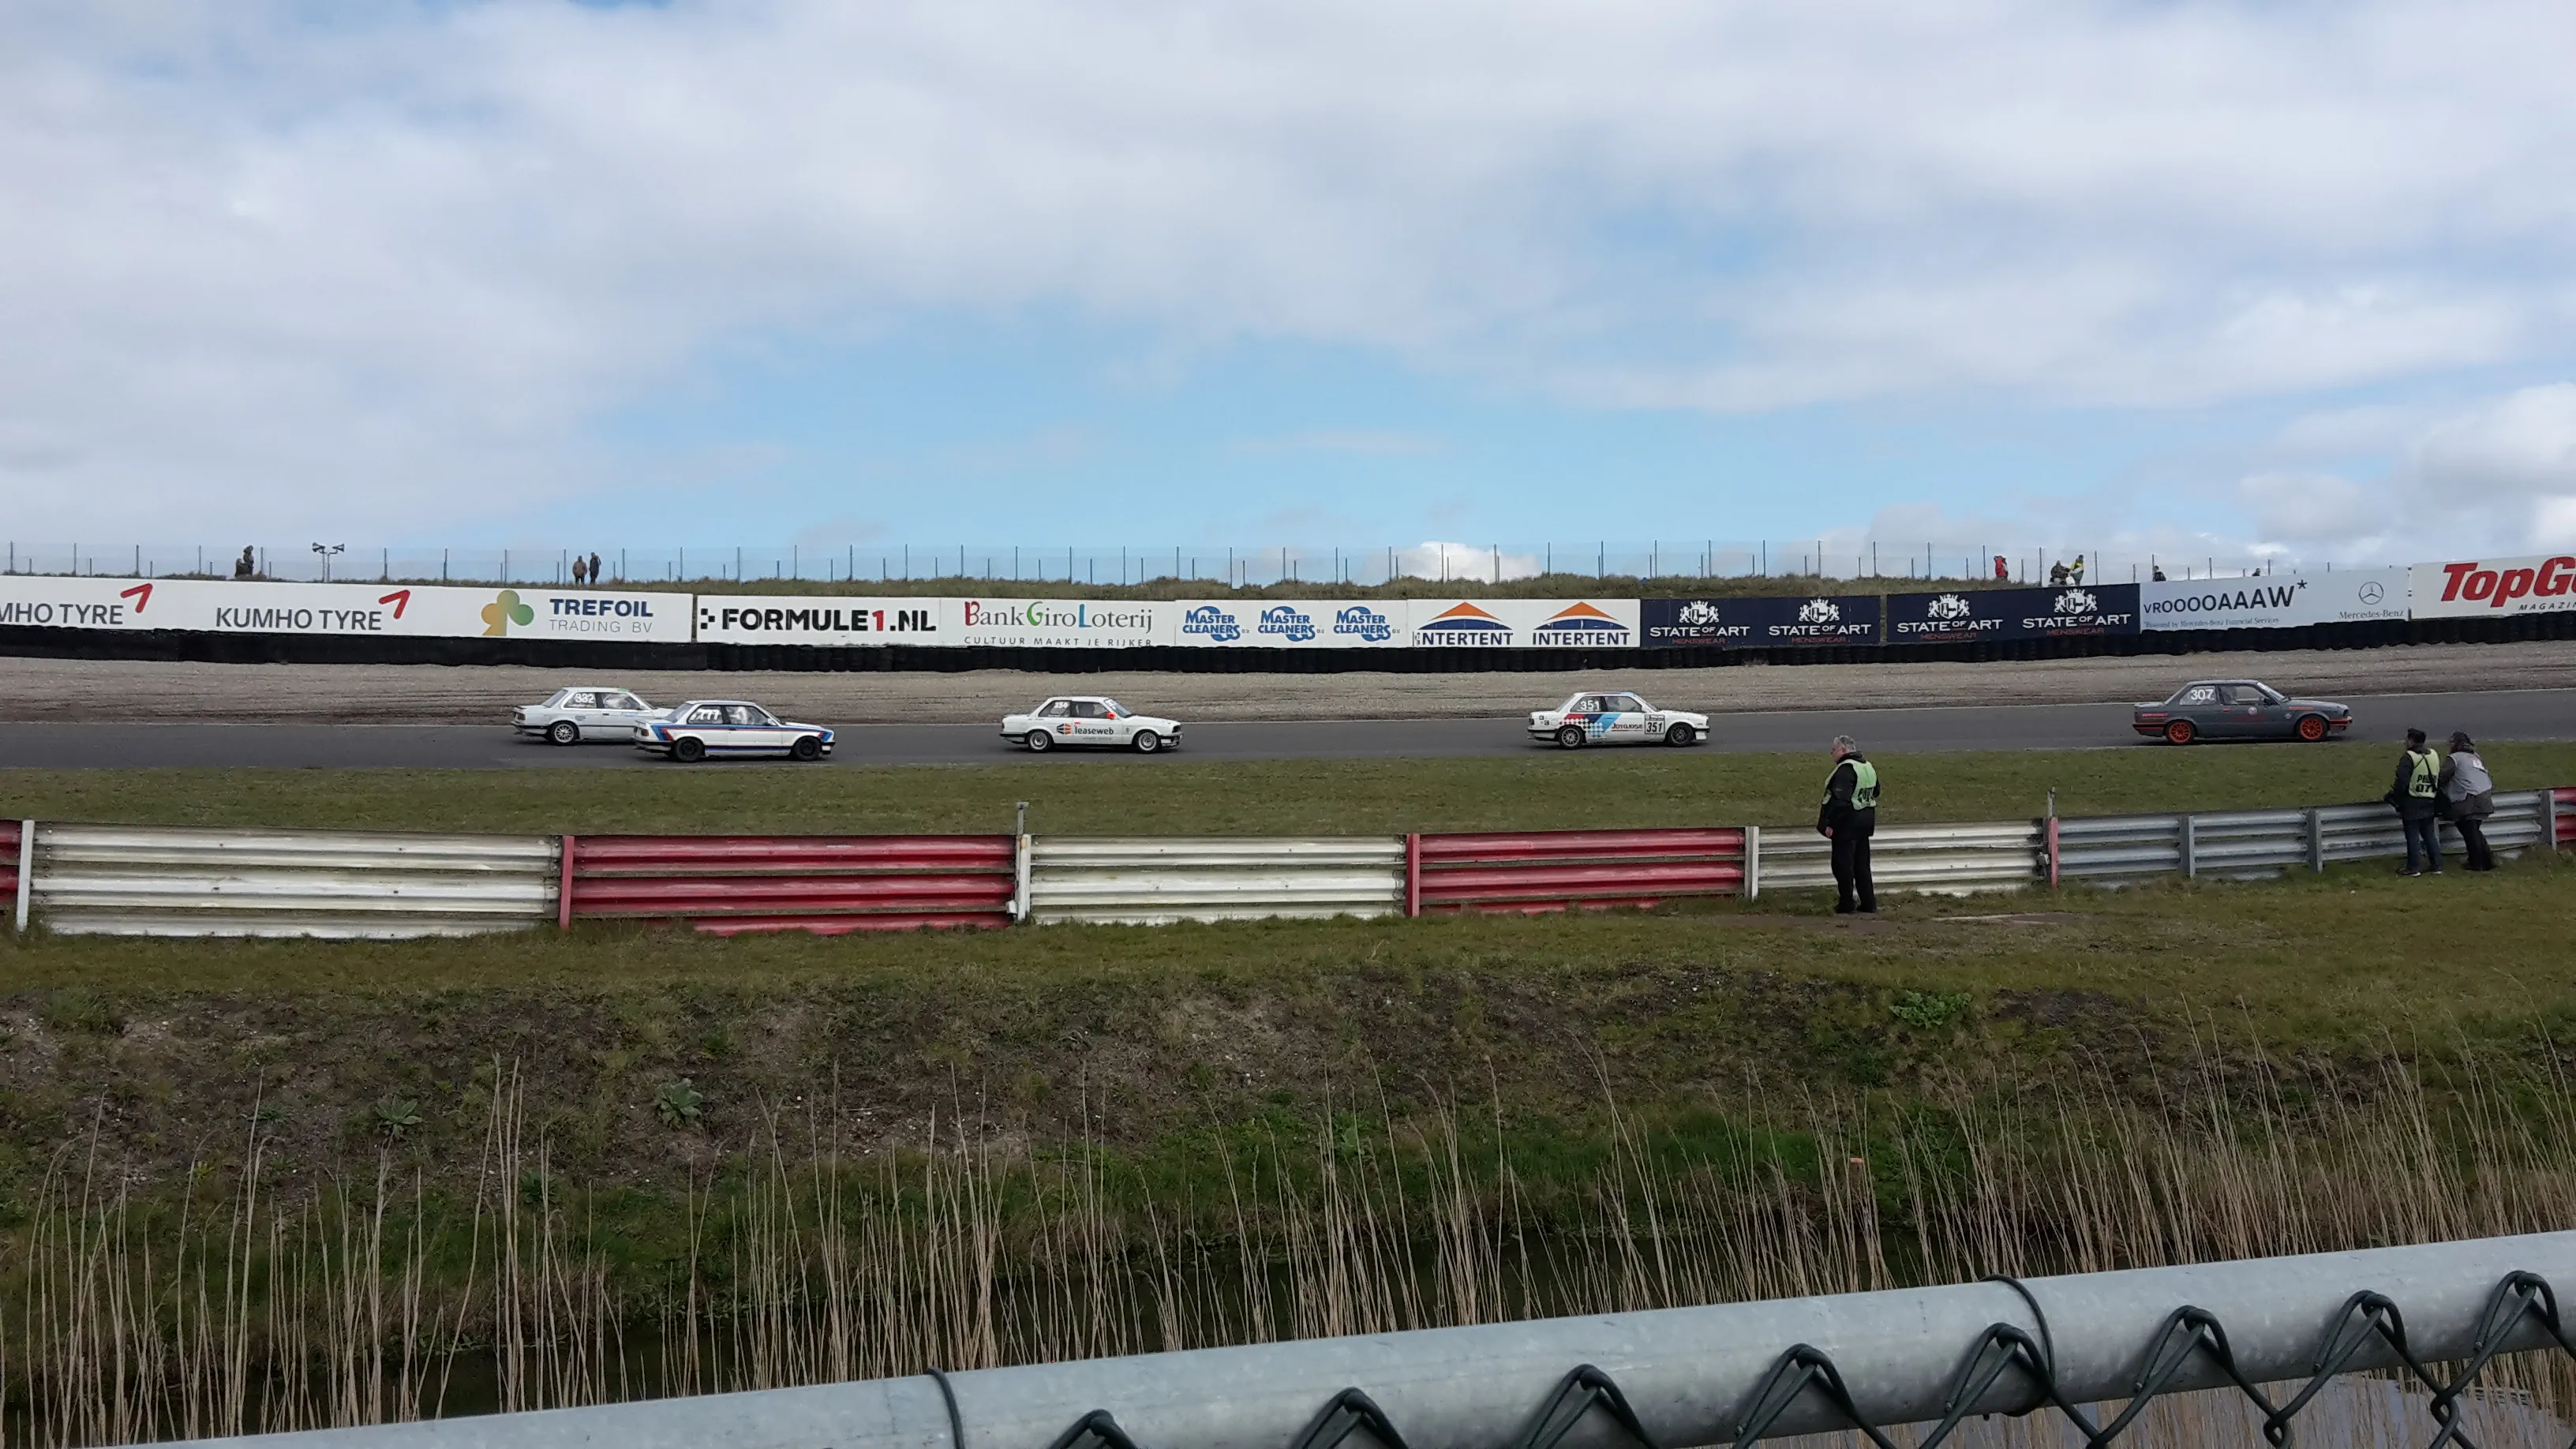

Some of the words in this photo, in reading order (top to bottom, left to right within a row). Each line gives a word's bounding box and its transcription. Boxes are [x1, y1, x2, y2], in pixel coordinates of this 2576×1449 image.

[2441, 556, 2576, 608] TopG
[549, 598, 654, 617] TREFOIL
[2339, 609, 2404, 620] Mercedes-Benz
[58, 605, 125, 625] TYRE
[215, 607, 313, 629] KUMHO
[318, 610, 383, 631] TYRE
[722, 608, 937, 631] FORMULE1.NL
[964, 601, 1152, 634] BankGiroLoterij
[1185, 610, 1235, 624] MASTER
[1260, 610, 1310, 624] MASTER
[1336, 610, 1386, 624] MASTER
[2022, 616, 2077, 629] STATE
[2095, 614, 2132, 626] ART
[549, 619, 621, 633] TRADING
[631, 622, 653, 633] BV
[1182, 624, 1241, 638] CLEANERS
[1258, 624, 1316, 638] CLEANERS
[1333, 624, 1391, 638] CLEANERS
[1649, 627, 1700, 637] STATE
[1716, 626, 1750, 637] ART
[1769, 625, 1820, 636] STATE
[1837, 624, 1871, 635] ART
[1897, 621, 1950, 633] STATE
[1968, 619, 2004, 630] ART
[964, 636, 1025, 645] CULTUUR
[1533, 632, 1631, 646] INTERTENT
[2190, 688, 2215, 701] 307
[1580, 698, 1601, 710] 351
[1075, 725, 1114, 735] leaseweb
[1646, 722, 1663, 732] 351
